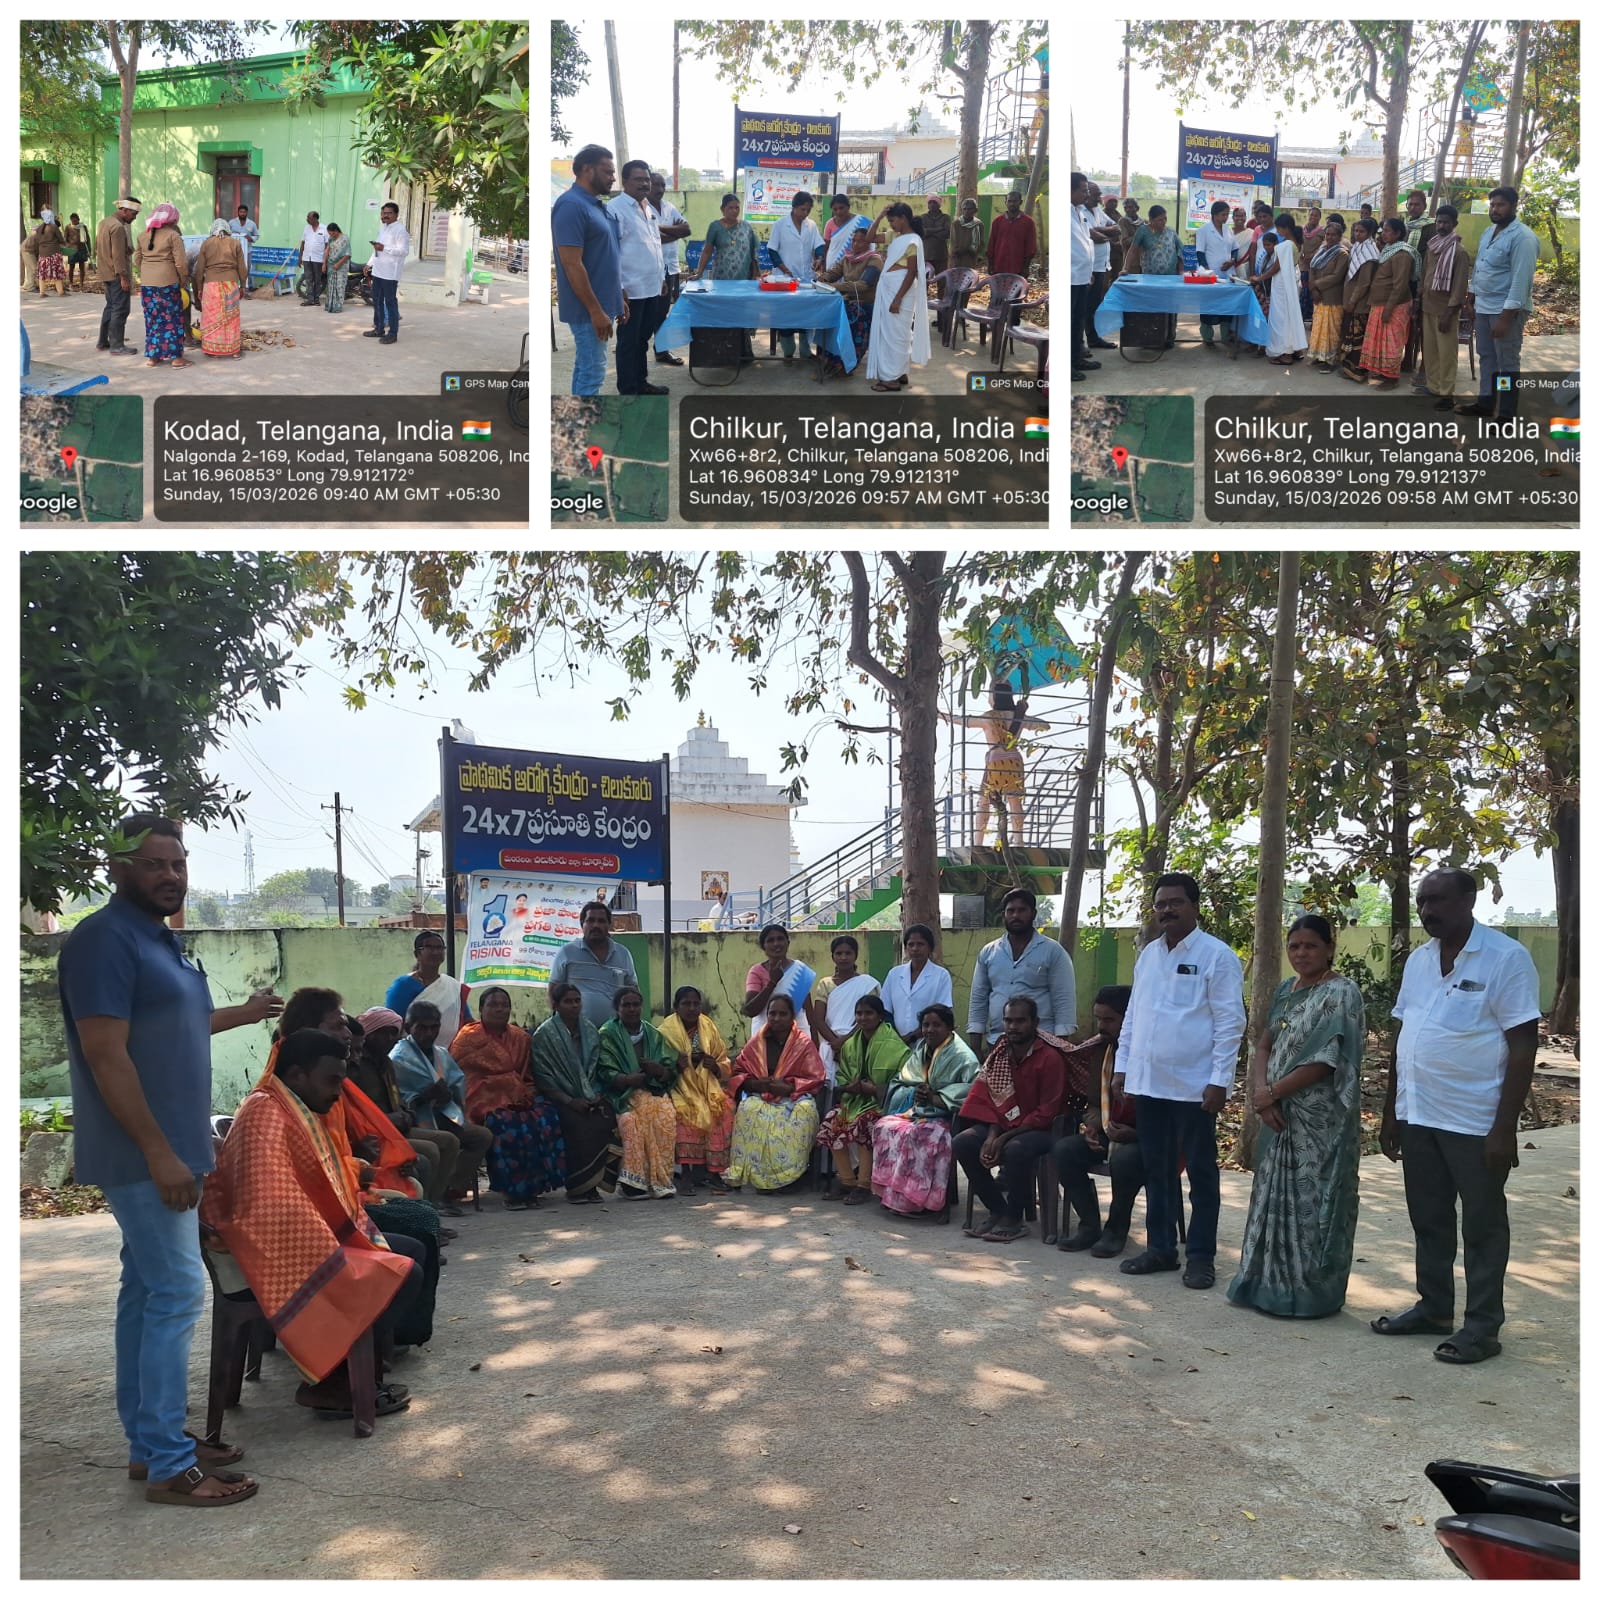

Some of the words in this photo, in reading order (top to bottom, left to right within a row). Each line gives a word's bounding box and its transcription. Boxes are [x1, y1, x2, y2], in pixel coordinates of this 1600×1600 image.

[600, 774, 652, 801] చిలుకూరు
[593, 805, 651, 849] కేంద్రం
[470, 946, 512, 961] RISING
